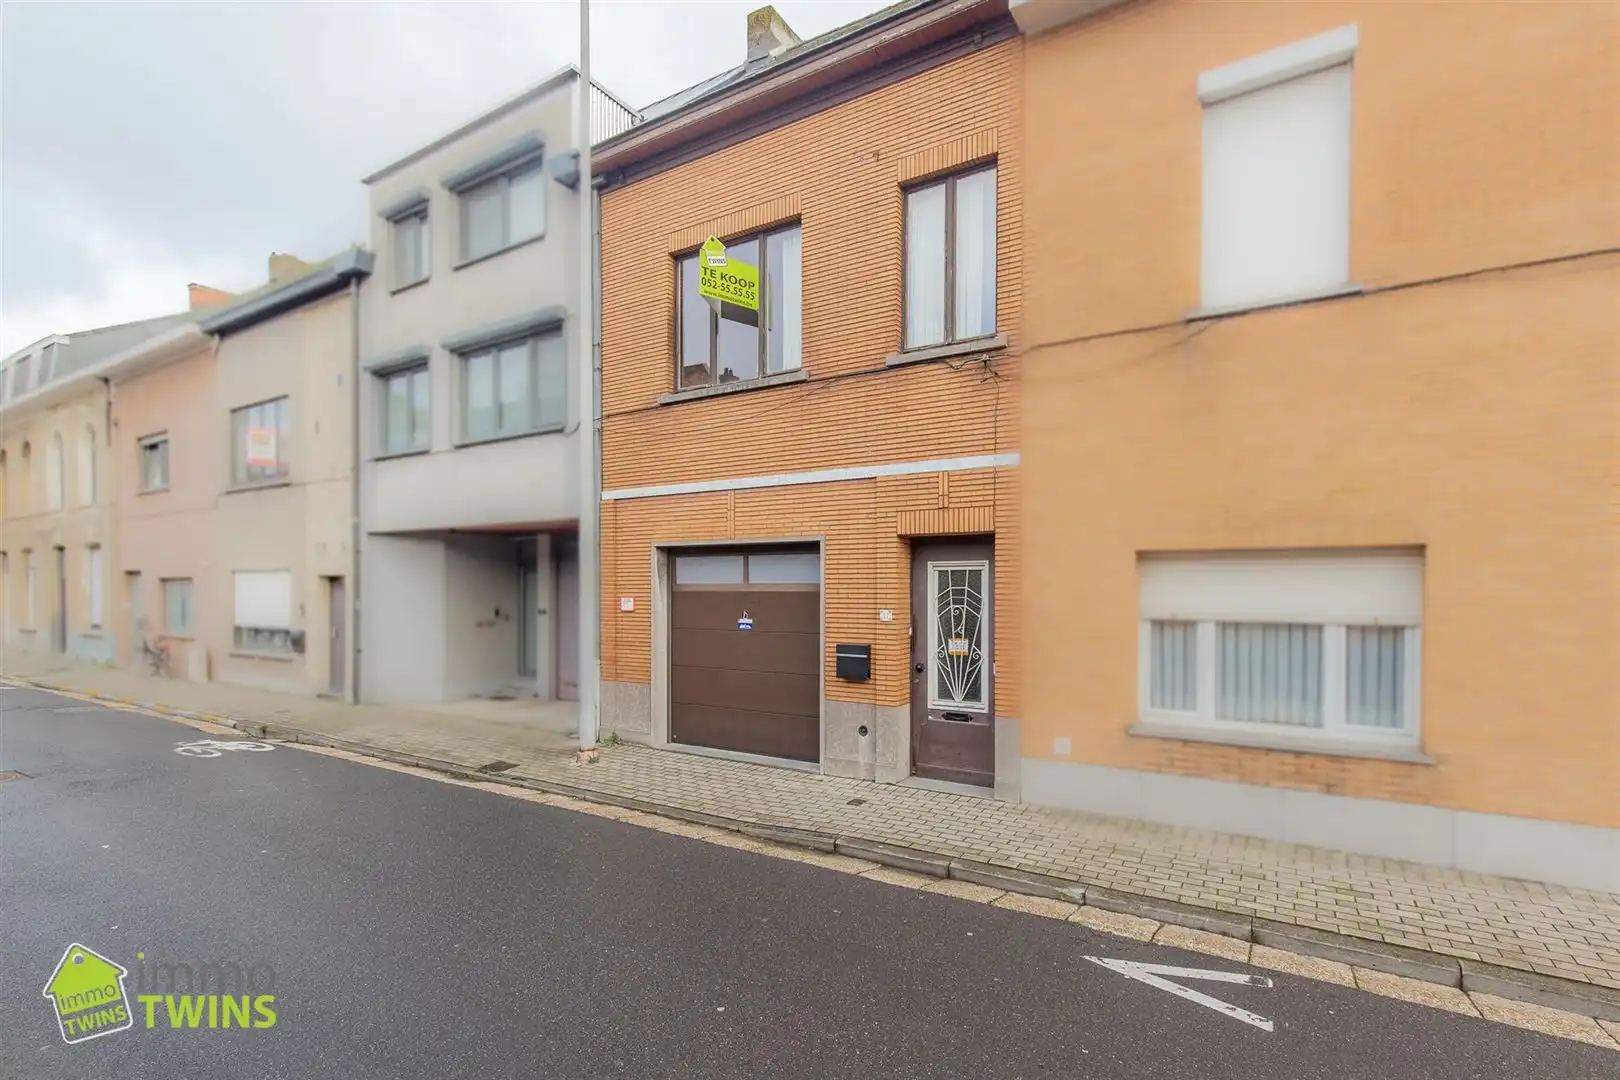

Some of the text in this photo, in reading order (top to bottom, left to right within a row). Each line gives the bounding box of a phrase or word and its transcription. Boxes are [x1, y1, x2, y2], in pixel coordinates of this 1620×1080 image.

[701, 277, 755, 300] 052-55.55.55
[702, 266, 755, 289] TE KOOP
